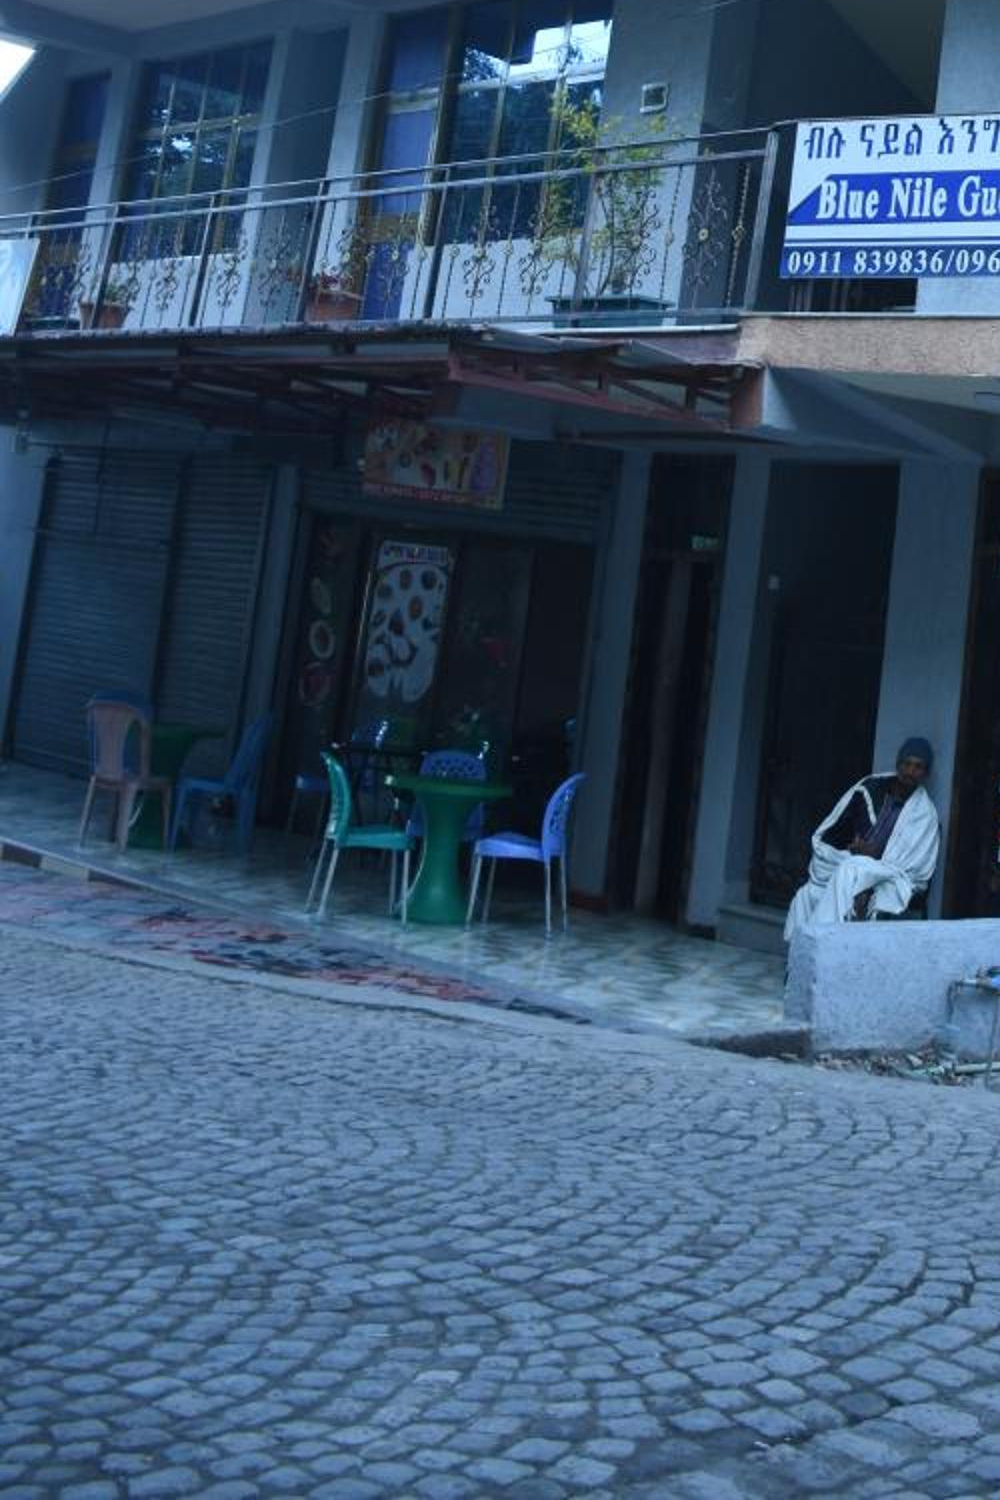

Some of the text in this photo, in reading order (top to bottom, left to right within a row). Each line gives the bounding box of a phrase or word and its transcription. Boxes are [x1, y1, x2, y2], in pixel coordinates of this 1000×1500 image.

[804, 126, 846, 159] ብሉ
[860, 123, 923, 159] ናይል
[816, 180, 878, 219] Blue
[887, 177, 947, 218] Nile
[787, 251, 841, 274] 0911
